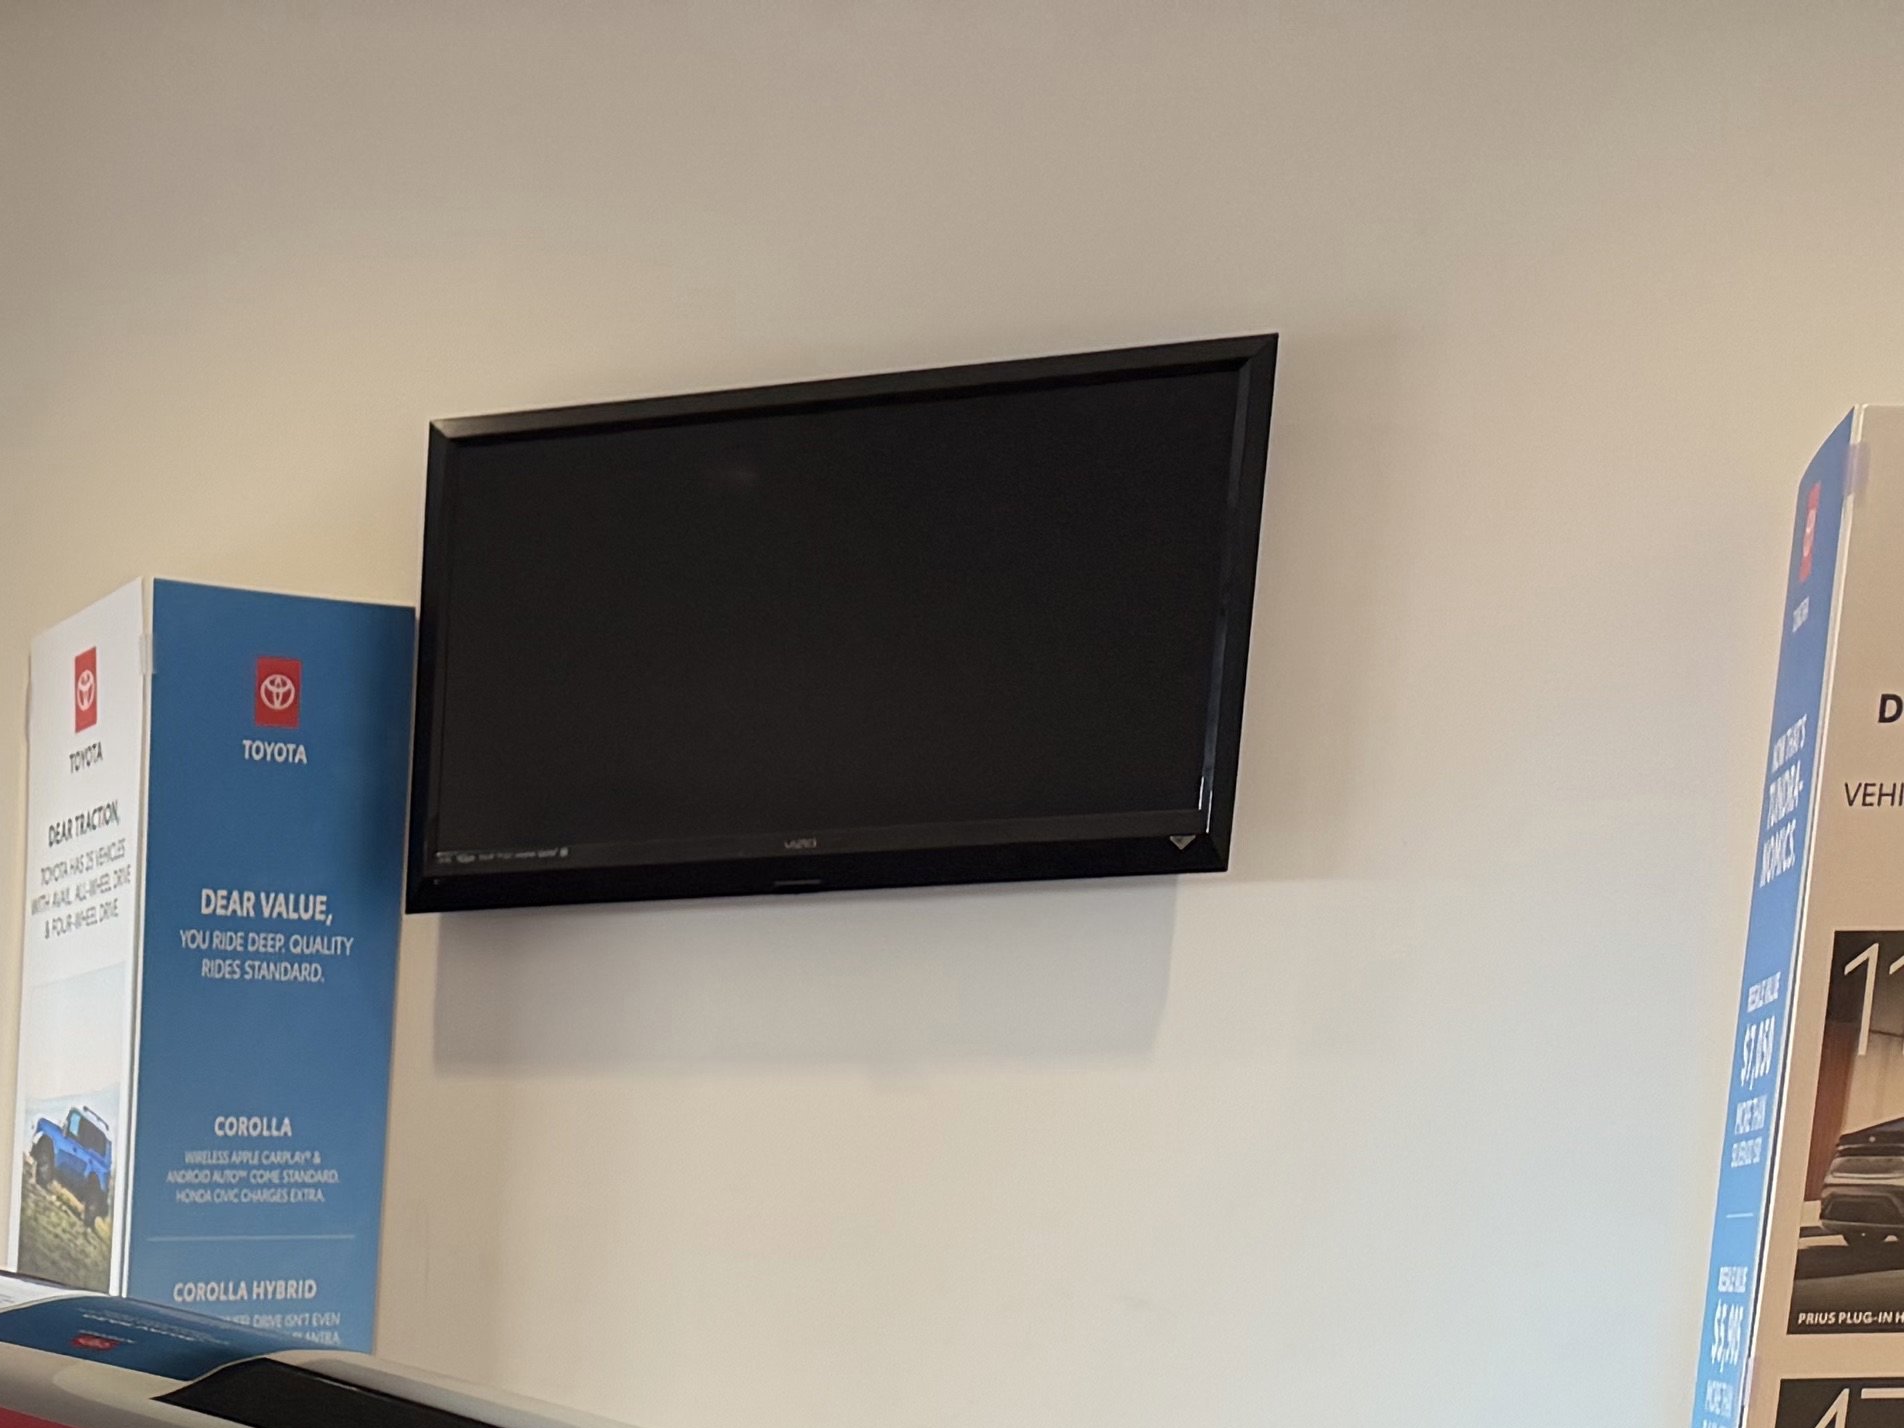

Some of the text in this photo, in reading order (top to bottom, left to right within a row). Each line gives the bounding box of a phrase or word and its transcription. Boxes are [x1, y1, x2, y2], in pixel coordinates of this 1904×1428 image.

[69, 741, 103, 774] TOYOTA
[242, 739, 308, 765] TOYOTA
[47, 818, 74, 848] DEAR
[201, 888, 333, 926] DEAR VALUE,
[179, 929, 354, 956] YOU RIDE DEEP. QUALITY
[201, 958, 325, 983] RIDES STANDARD.
[214, 1116, 293, 1137] COROLLA
[173, 1279, 317, 1302] COROLLA HYBRID
[1797, 1311, 1836, 1325] PRIUS
[1838, 1311, 1893, 1324] PLUG-IN
